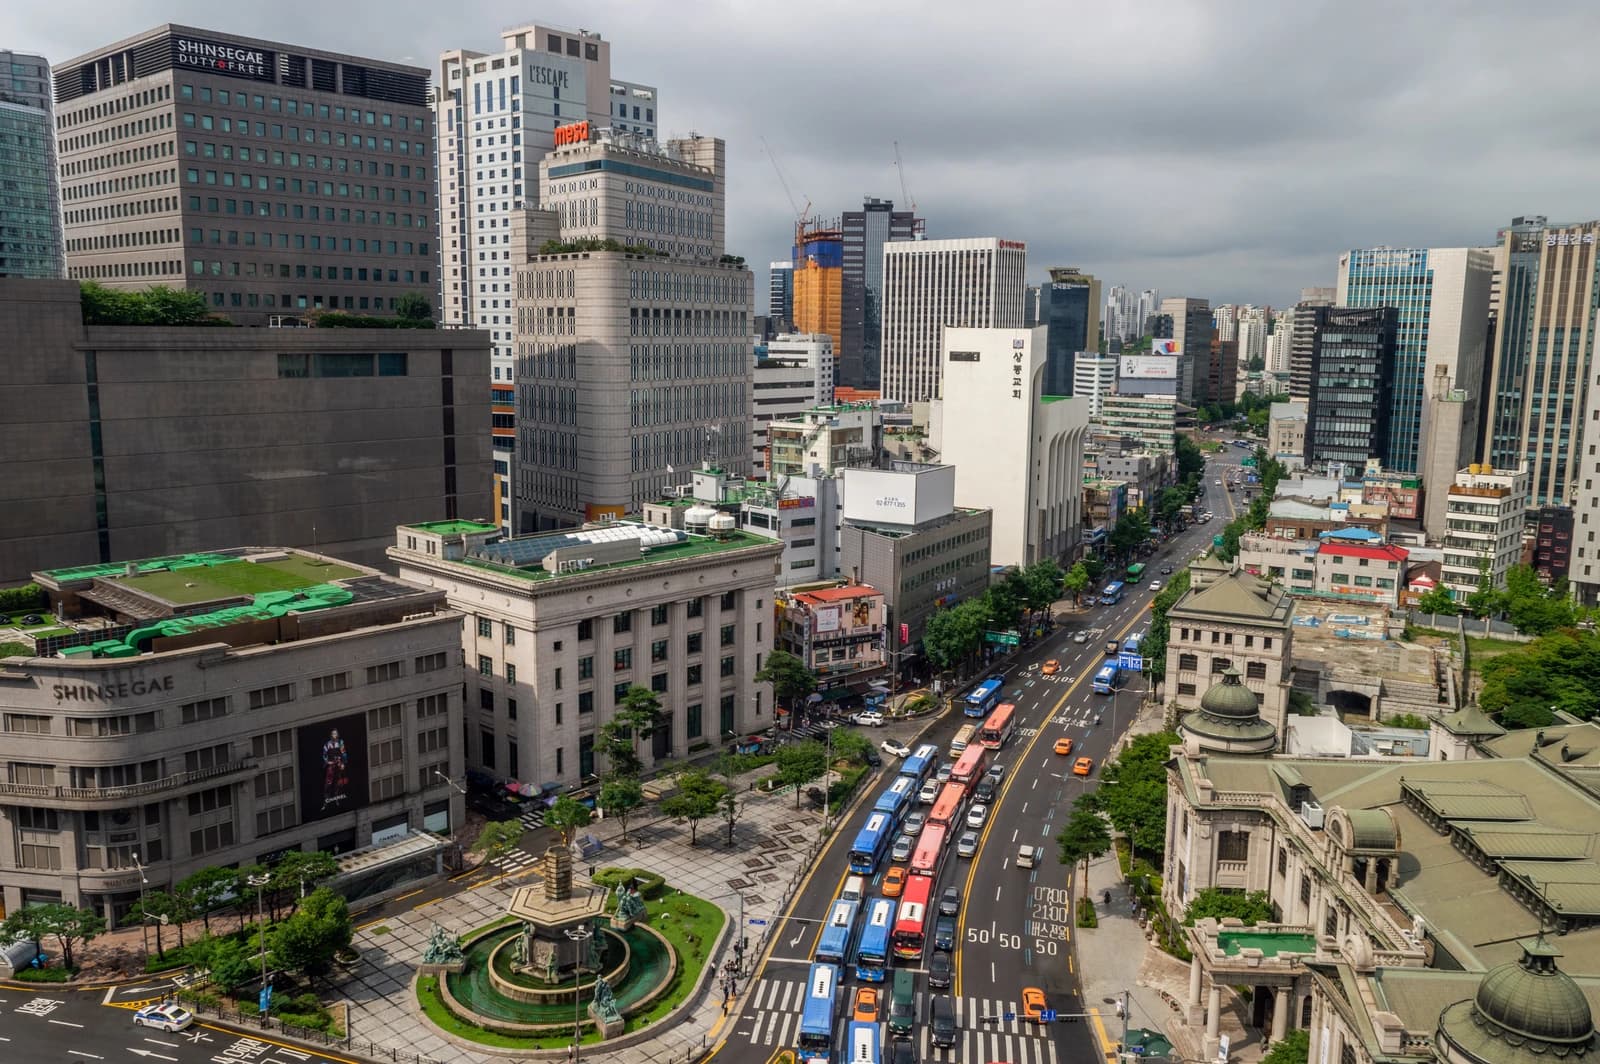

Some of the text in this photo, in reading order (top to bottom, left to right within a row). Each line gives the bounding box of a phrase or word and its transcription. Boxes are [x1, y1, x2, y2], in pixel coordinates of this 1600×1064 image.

[178, 40, 264, 65] SHINSEGAE
[179, 53, 264, 76] DUTY FREE
[529, 65, 569, 89] L'ESCAPE
[554, 120, 588, 146] mesa
[1012, 352, 1023, 399] 상동교회
[53, 675, 175, 702] SHINSEGAE
[968, 927, 989, 943] 50
[1000, 933, 1021, 949] 50
[1031, 922, 1066, 940] 버스전용
[1035, 939, 1057, 955] 50
